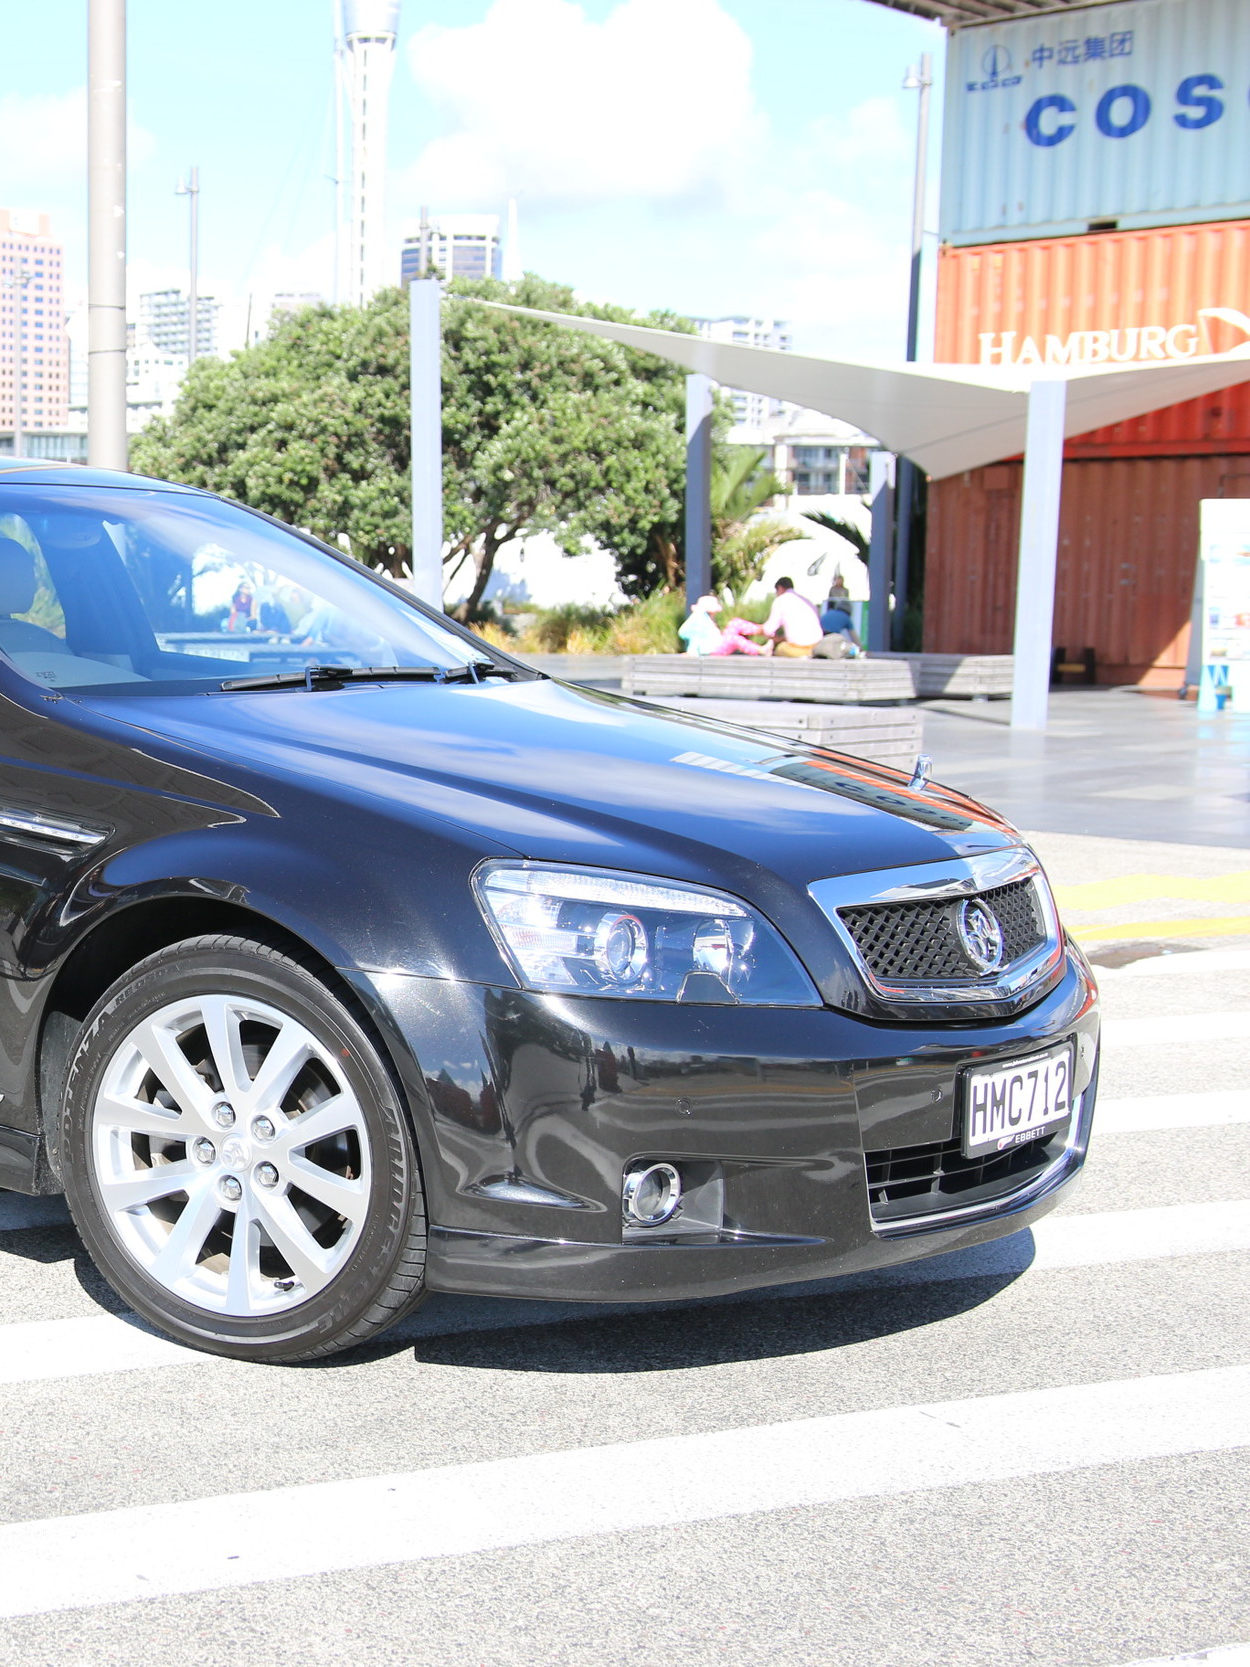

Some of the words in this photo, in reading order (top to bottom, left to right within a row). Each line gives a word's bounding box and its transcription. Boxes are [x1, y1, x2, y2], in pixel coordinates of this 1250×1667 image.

[1031, 30, 1135, 69] 中远集团
[1025, 73, 1250, 147] COS
[978, 322, 1200, 367] HAMBURG
[62, 1008, 112, 1164] POTENZA
[971, 1060, 1068, 1137] HMC712
[1014, 1126, 1046, 1144] EBBETT
